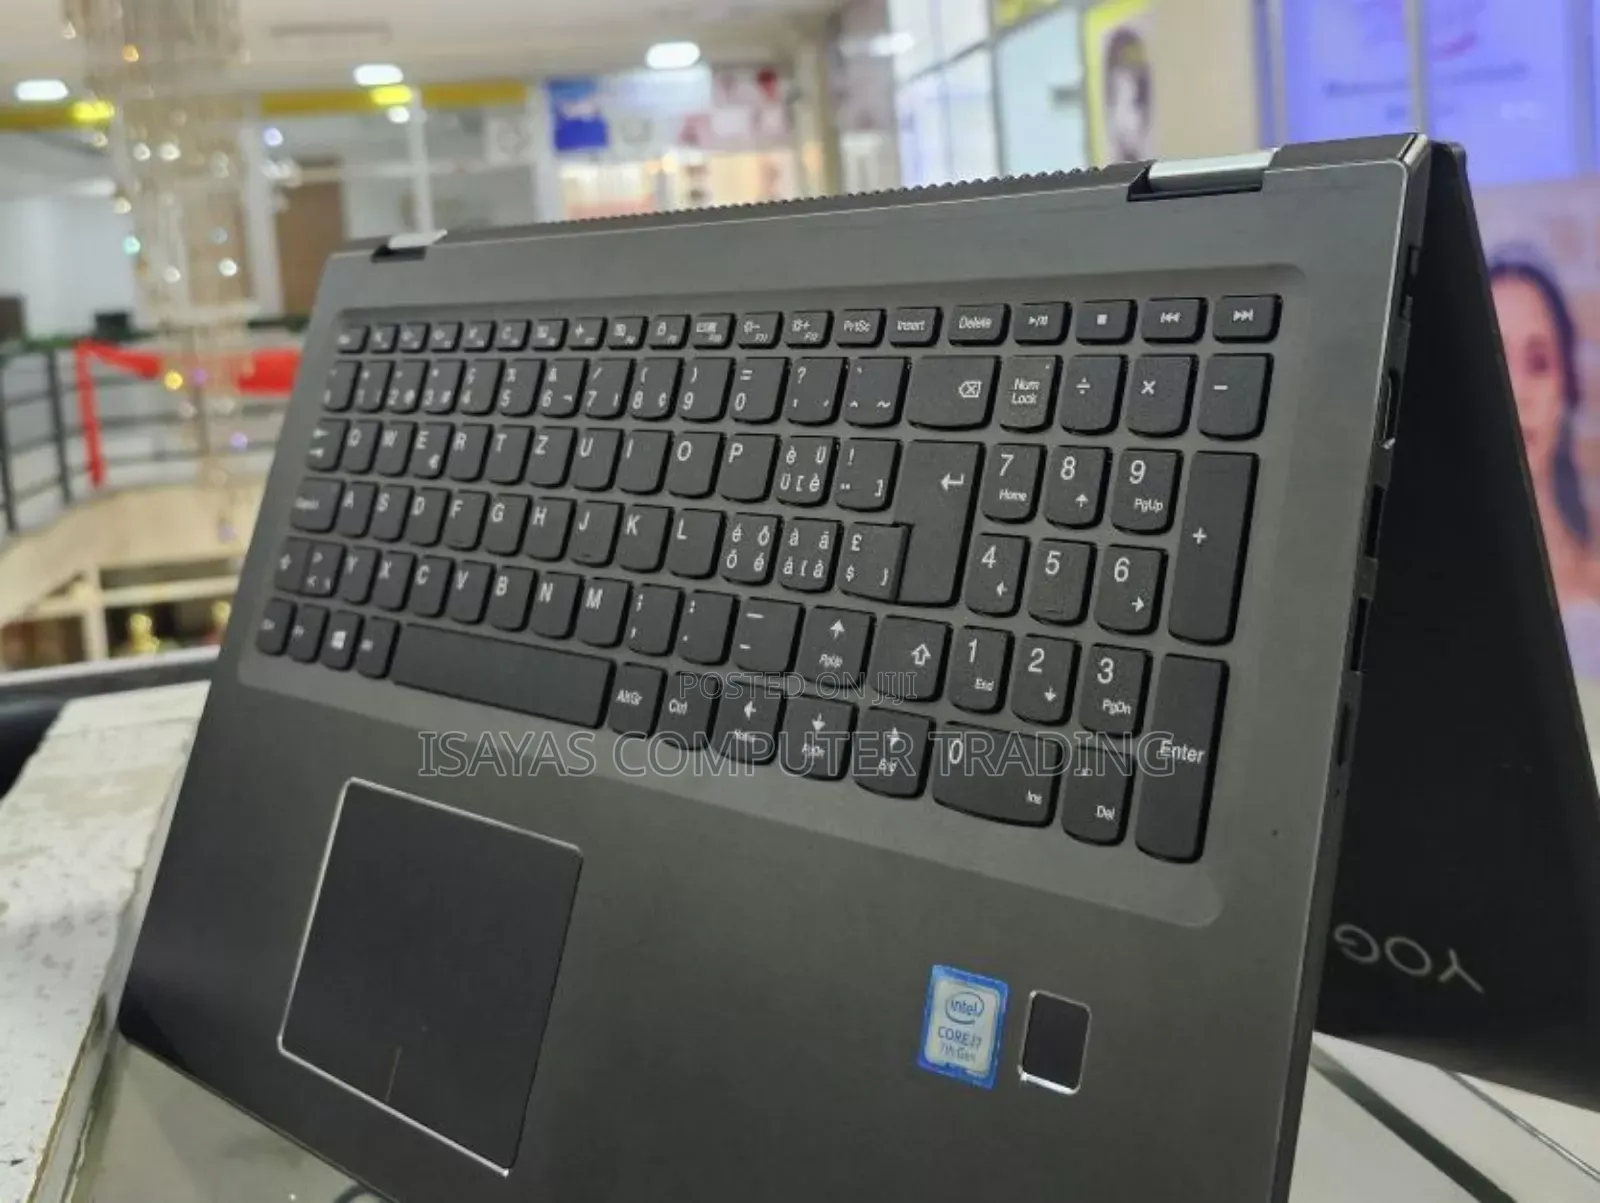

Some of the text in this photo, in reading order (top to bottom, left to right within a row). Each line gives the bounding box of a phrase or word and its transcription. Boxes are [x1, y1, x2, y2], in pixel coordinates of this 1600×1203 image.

[843, 320, 872, 332] PrtSc
[896, 319, 926, 331] Insert
[957, 315, 992, 330] Delete
[1013, 376, 1040, 391] Num
[500, 388, 512, 408] 5
[542, 389, 554, 407] 6
[586, 390, 598, 411] 7
[632, 390, 644, 410] 8
[682, 390, 695, 410] 9
[734, 392, 747, 411] 0
[1011, 391, 1038, 405] Lock
[347, 428, 362, 447] Q
[382, 429, 398, 448] W
[416, 430, 430, 449] E
[454, 431, 468, 450] R
[496, 433, 508, 453] T
[534, 434, 549, 455] Z
[579, 436, 594, 458] U
[625, 438, 635, 459] I
[676, 440, 693, 461] O
[728, 442, 744, 463] P
[999, 453, 1015, 477] 7
[1059, 455, 1077, 481] 8
[1128, 459, 1147, 485] 9
[343, 490, 355, 509] A
[377, 492, 391, 513] S
[999, 488, 1028, 502] Home
[1133, 497, 1164, 513] PgUp
[412, 496, 426, 516] D
[451, 499, 464, 519] F
[491, 502, 506, 523] G
[532, 506, 548, 527] H
[578, 511, 591, 531] J
[625, 514, 641, 536] K
[676, 518, 688, 540] L
[980, 545, 997, 570] 4
[1044, 550, 1062, 576] 5
[378, 559, 393, 580] X
[415, 564, 431, 586] C
[1113, 556, 1131, 583] 6
[456, 569, 470, 592] V
[495, 575, 509, 597] B
[538, 581, 554, 604] N
[585, 586, 604, 611] M
[967, 638, 979, 664] 1
[1027, 646, 1046, 674] 2
[1096, 657, 1115, 685] 3
[668, 699, 689, 716] Ctrl
[1101, 699, 1132, 715] PgDn
[948, 738, 965, 765] 0
[1159, 739, 1206, 765] Enter
[1025, 789, 1043, 805] Ins
[1095, 804, 1116, 821] Del
[951, 999, 977, 1016] intel
[938, 1026, 969, 1046] CORE
[956, 1047, 976, 1062] Gen
